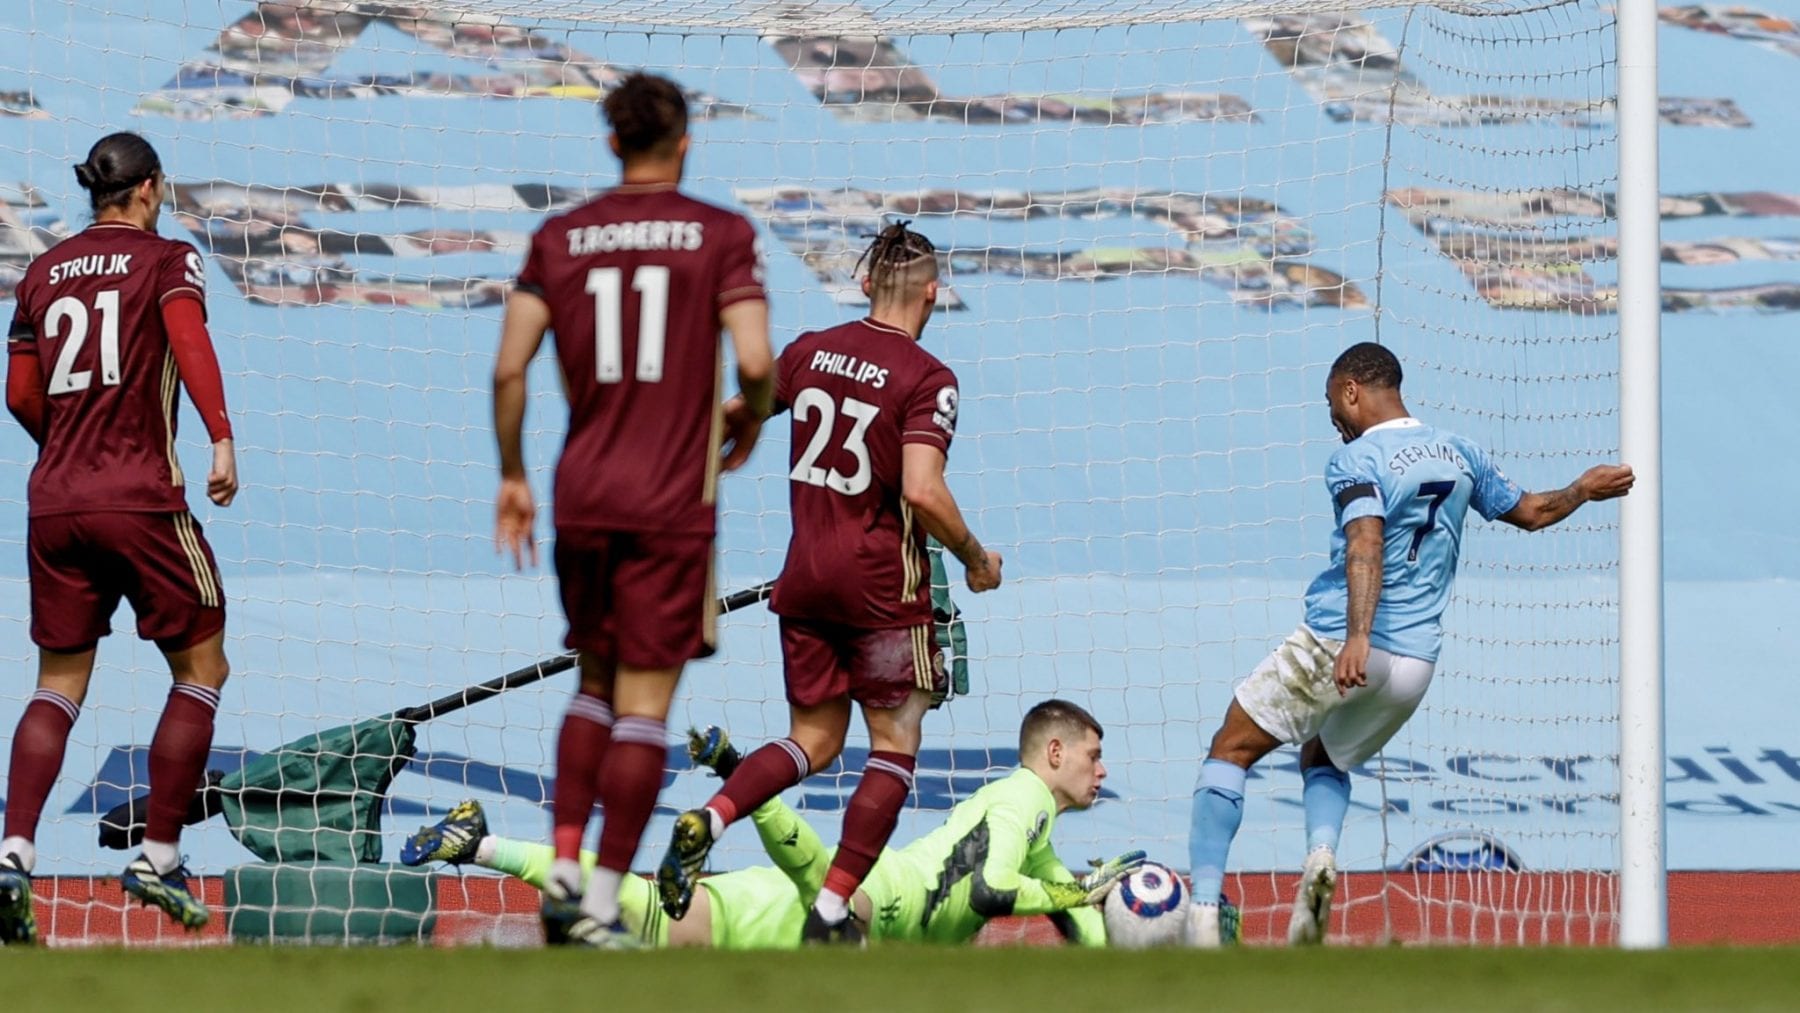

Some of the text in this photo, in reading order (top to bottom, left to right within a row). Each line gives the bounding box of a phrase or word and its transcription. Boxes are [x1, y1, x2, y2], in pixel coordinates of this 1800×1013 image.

[565, 220, 704, 257] T.ROBERTS
[49, 254, 132, 285] STRUIJK
[44, 289, 121, 396] 21
[584, 264, 671, 384] 11
[810, 350, 889, 389] PHILLIPS
[789, 387, 881, 496] 23
[1388, 443, 1465, 476] STERLING
[1406, 479, 1457, 562] 7
